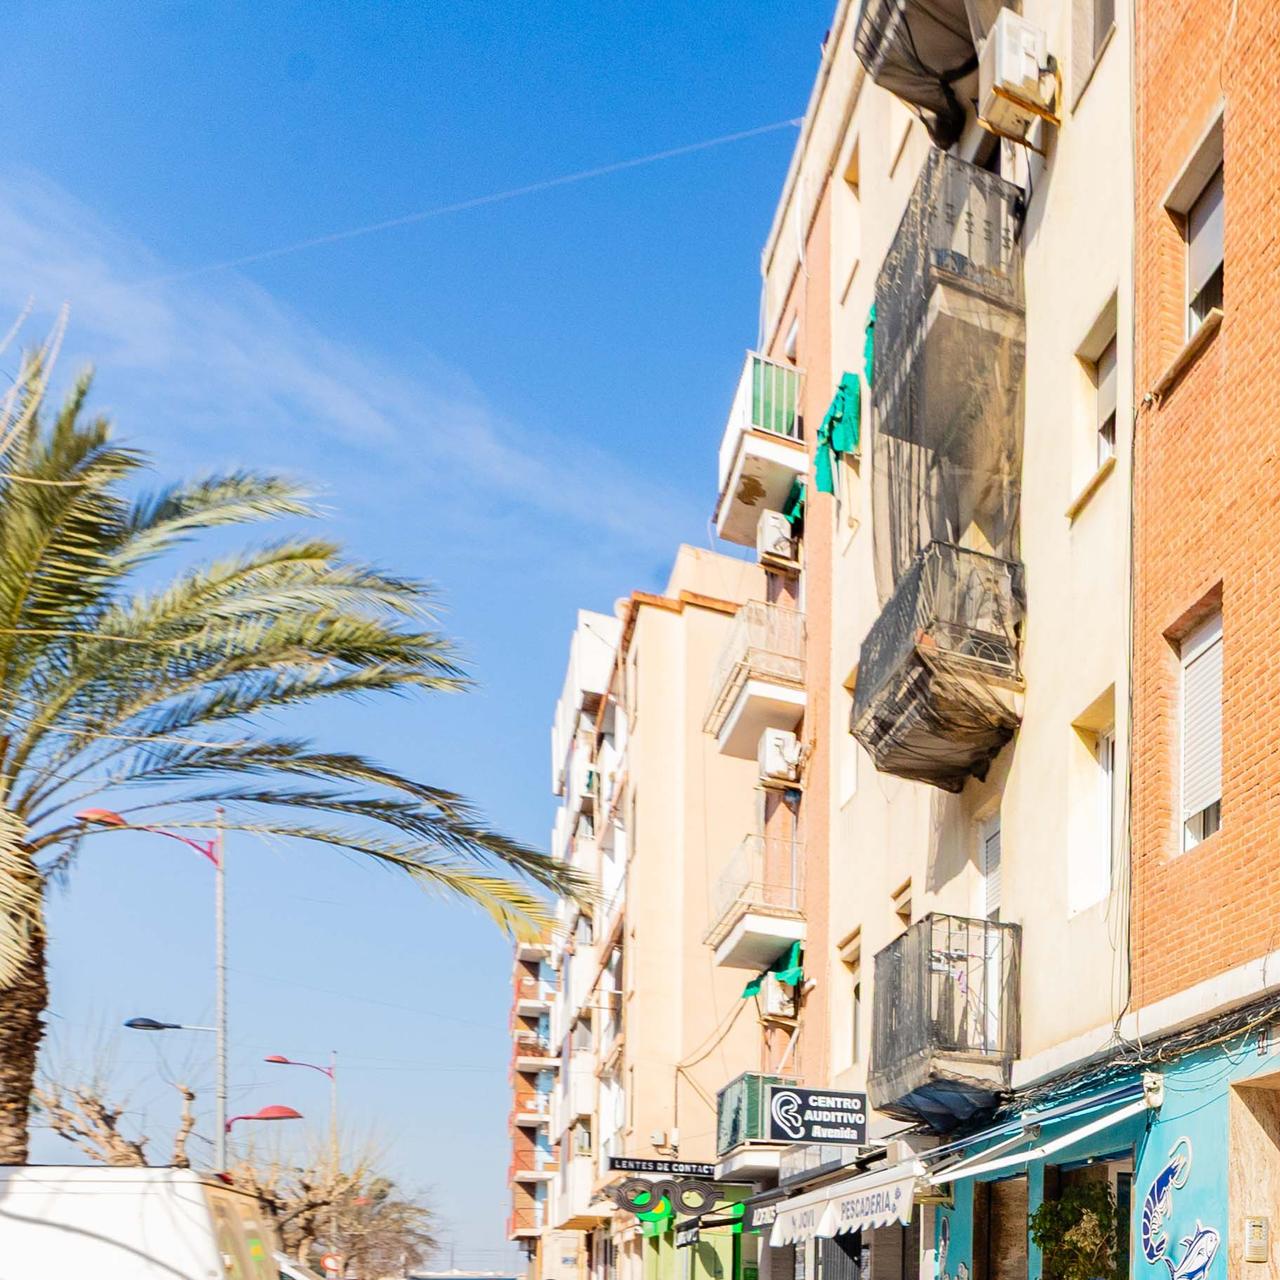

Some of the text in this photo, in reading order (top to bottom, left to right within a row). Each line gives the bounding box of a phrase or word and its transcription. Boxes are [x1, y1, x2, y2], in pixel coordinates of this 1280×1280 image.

[808, 1095, 861, 1110] CENTRO
[804, 1109, 865, 1125] AUDITIVO
[811, 1125, 858, 1139] Avenida
[614, 1160, 654, 1170] LENTES
[656, 1163, 670, 1171] DE
[840, 1190, 891, 1221] PESCADERIA
